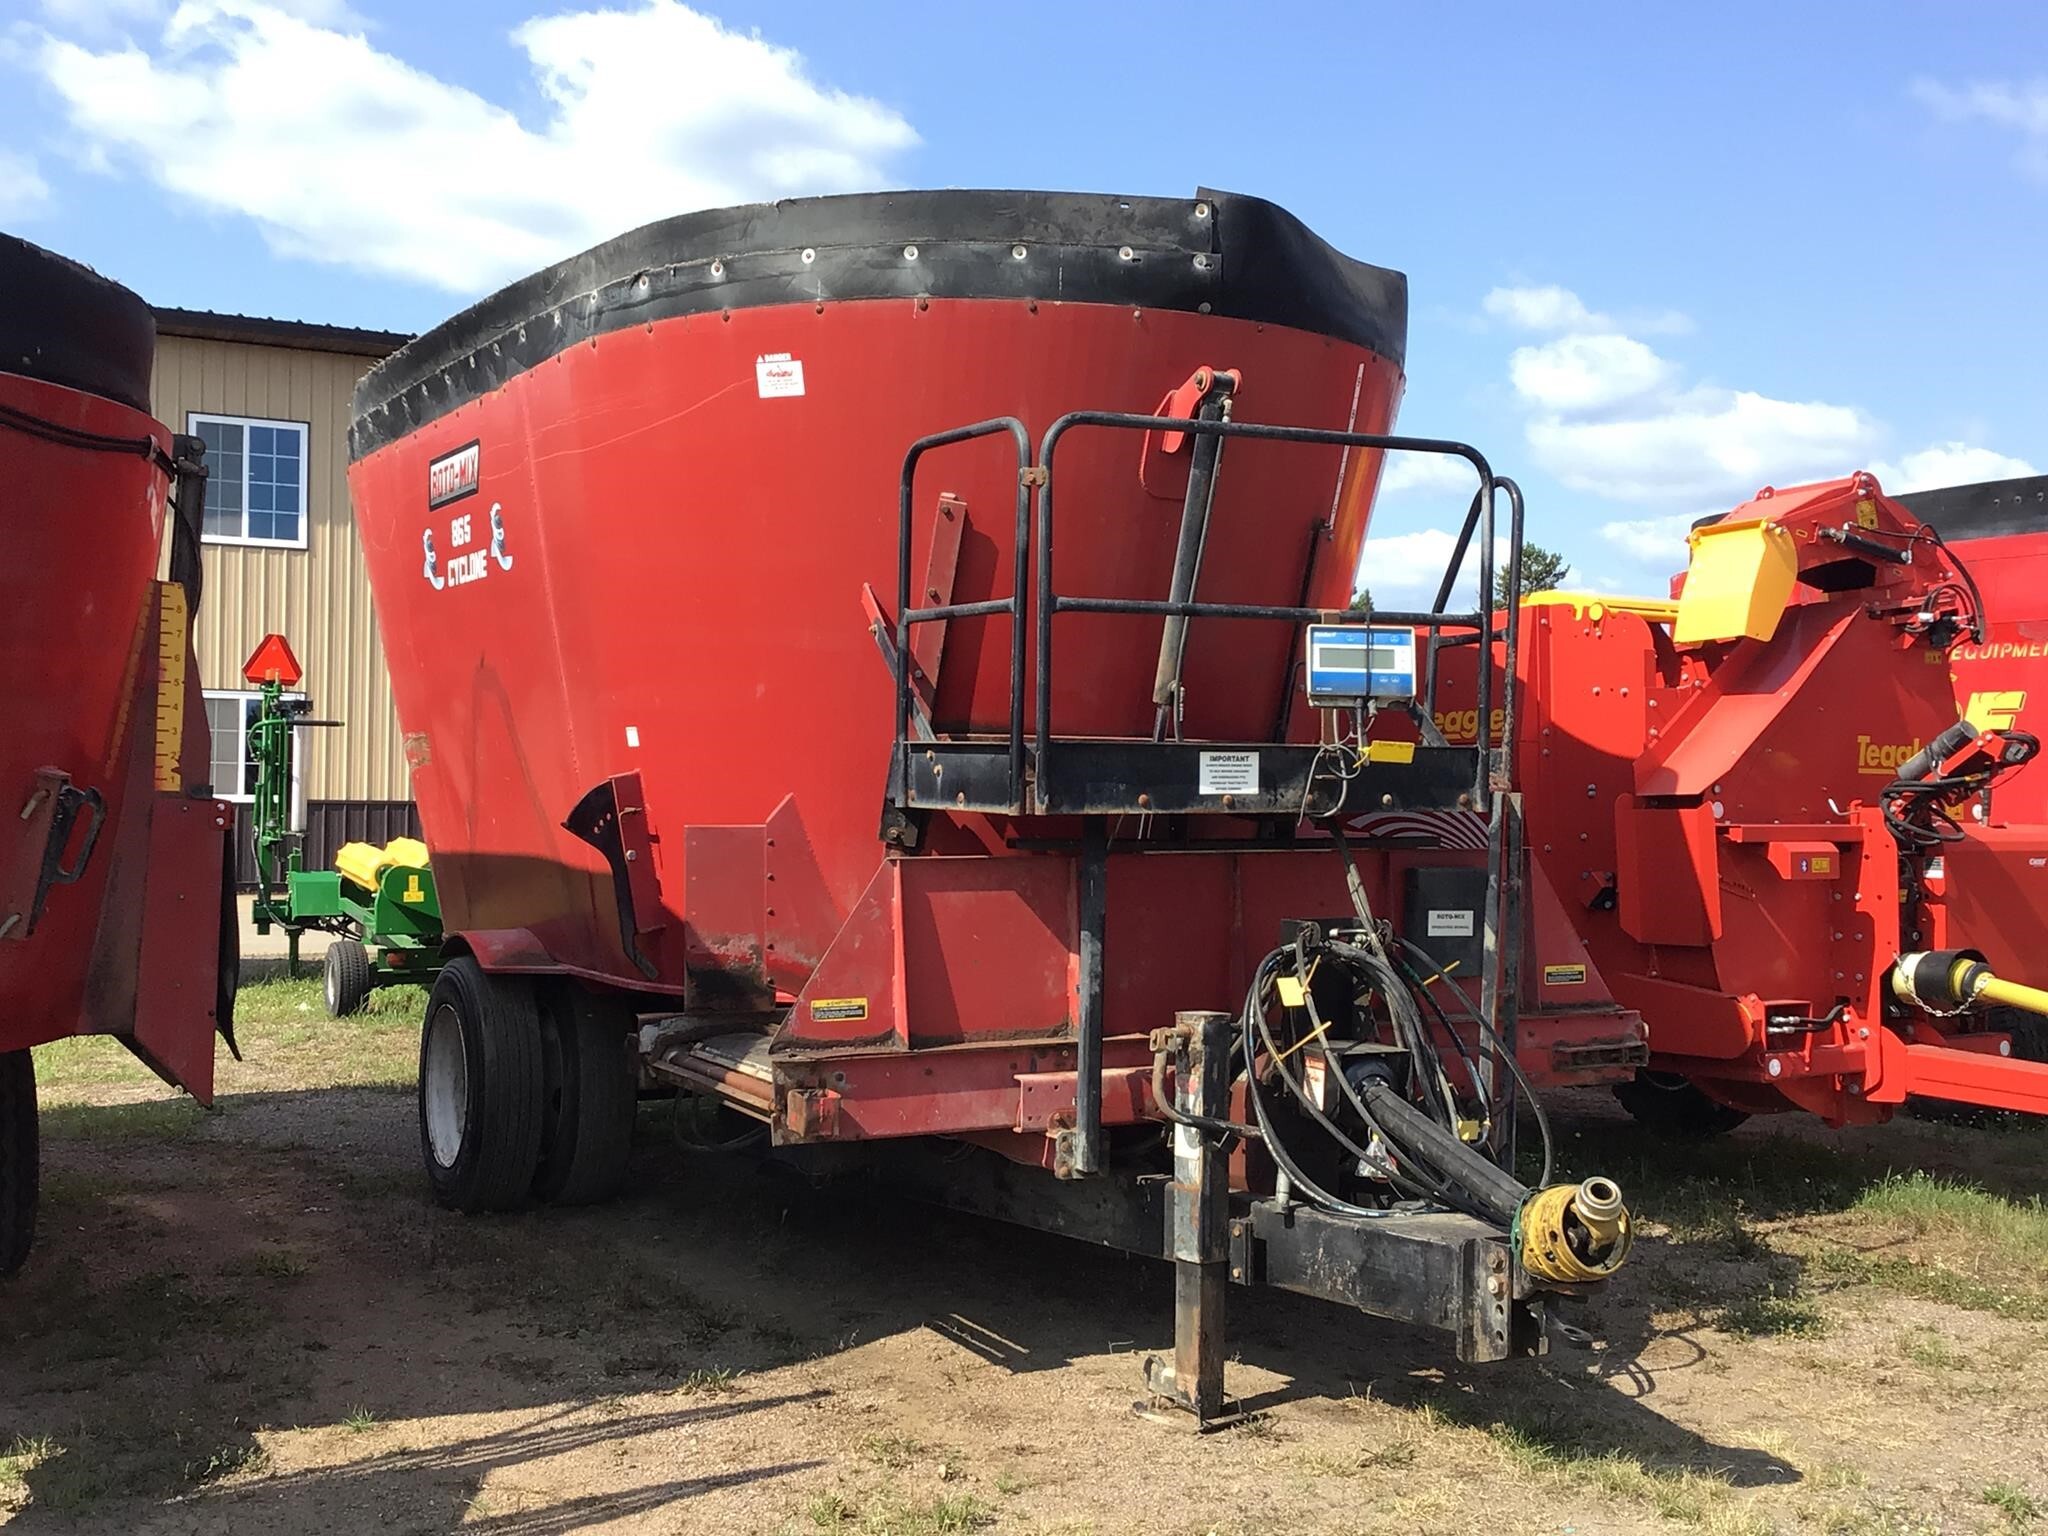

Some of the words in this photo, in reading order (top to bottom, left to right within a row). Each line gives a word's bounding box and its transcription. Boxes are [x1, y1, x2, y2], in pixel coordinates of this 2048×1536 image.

[432, 452, 477, 499] ROTO-MIX
[451, 514, 471, 547] 865
[447, 548, 488, 588] CYCLONE
